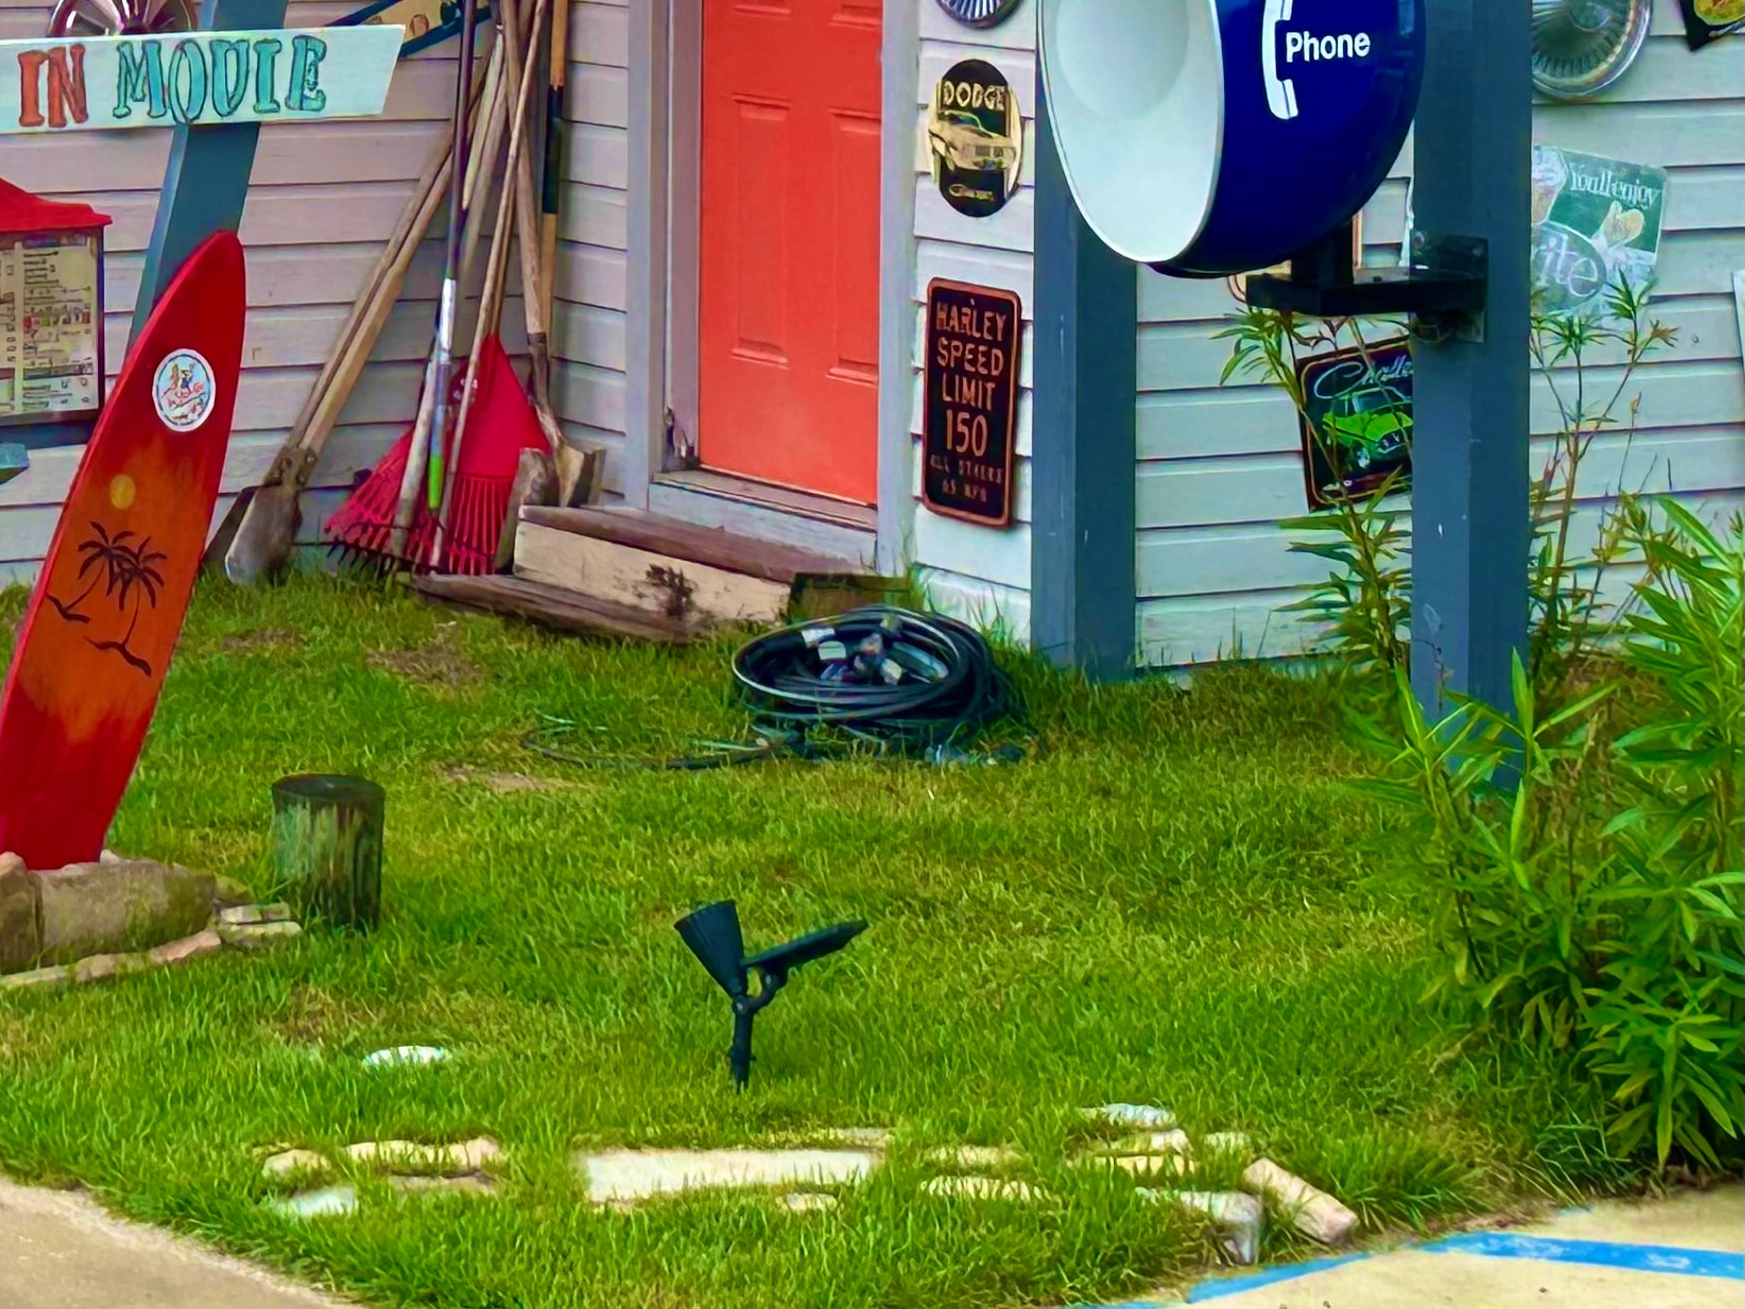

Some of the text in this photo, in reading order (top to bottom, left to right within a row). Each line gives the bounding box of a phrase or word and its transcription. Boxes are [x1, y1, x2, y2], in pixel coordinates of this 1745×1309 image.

[1286, 31, 1371, 63] Phone
[17, 43, 89, 129] IN
[112, 34, 327, 126] MOVIE
[943, 80, 1005, 111] DODGE
[936, 301, 1006, 342] HARLEY
[936, 337, 1004, 377] SPEED
[942, 372, 996, 412] LIMIT
[946, 409, 988, 458] 150
